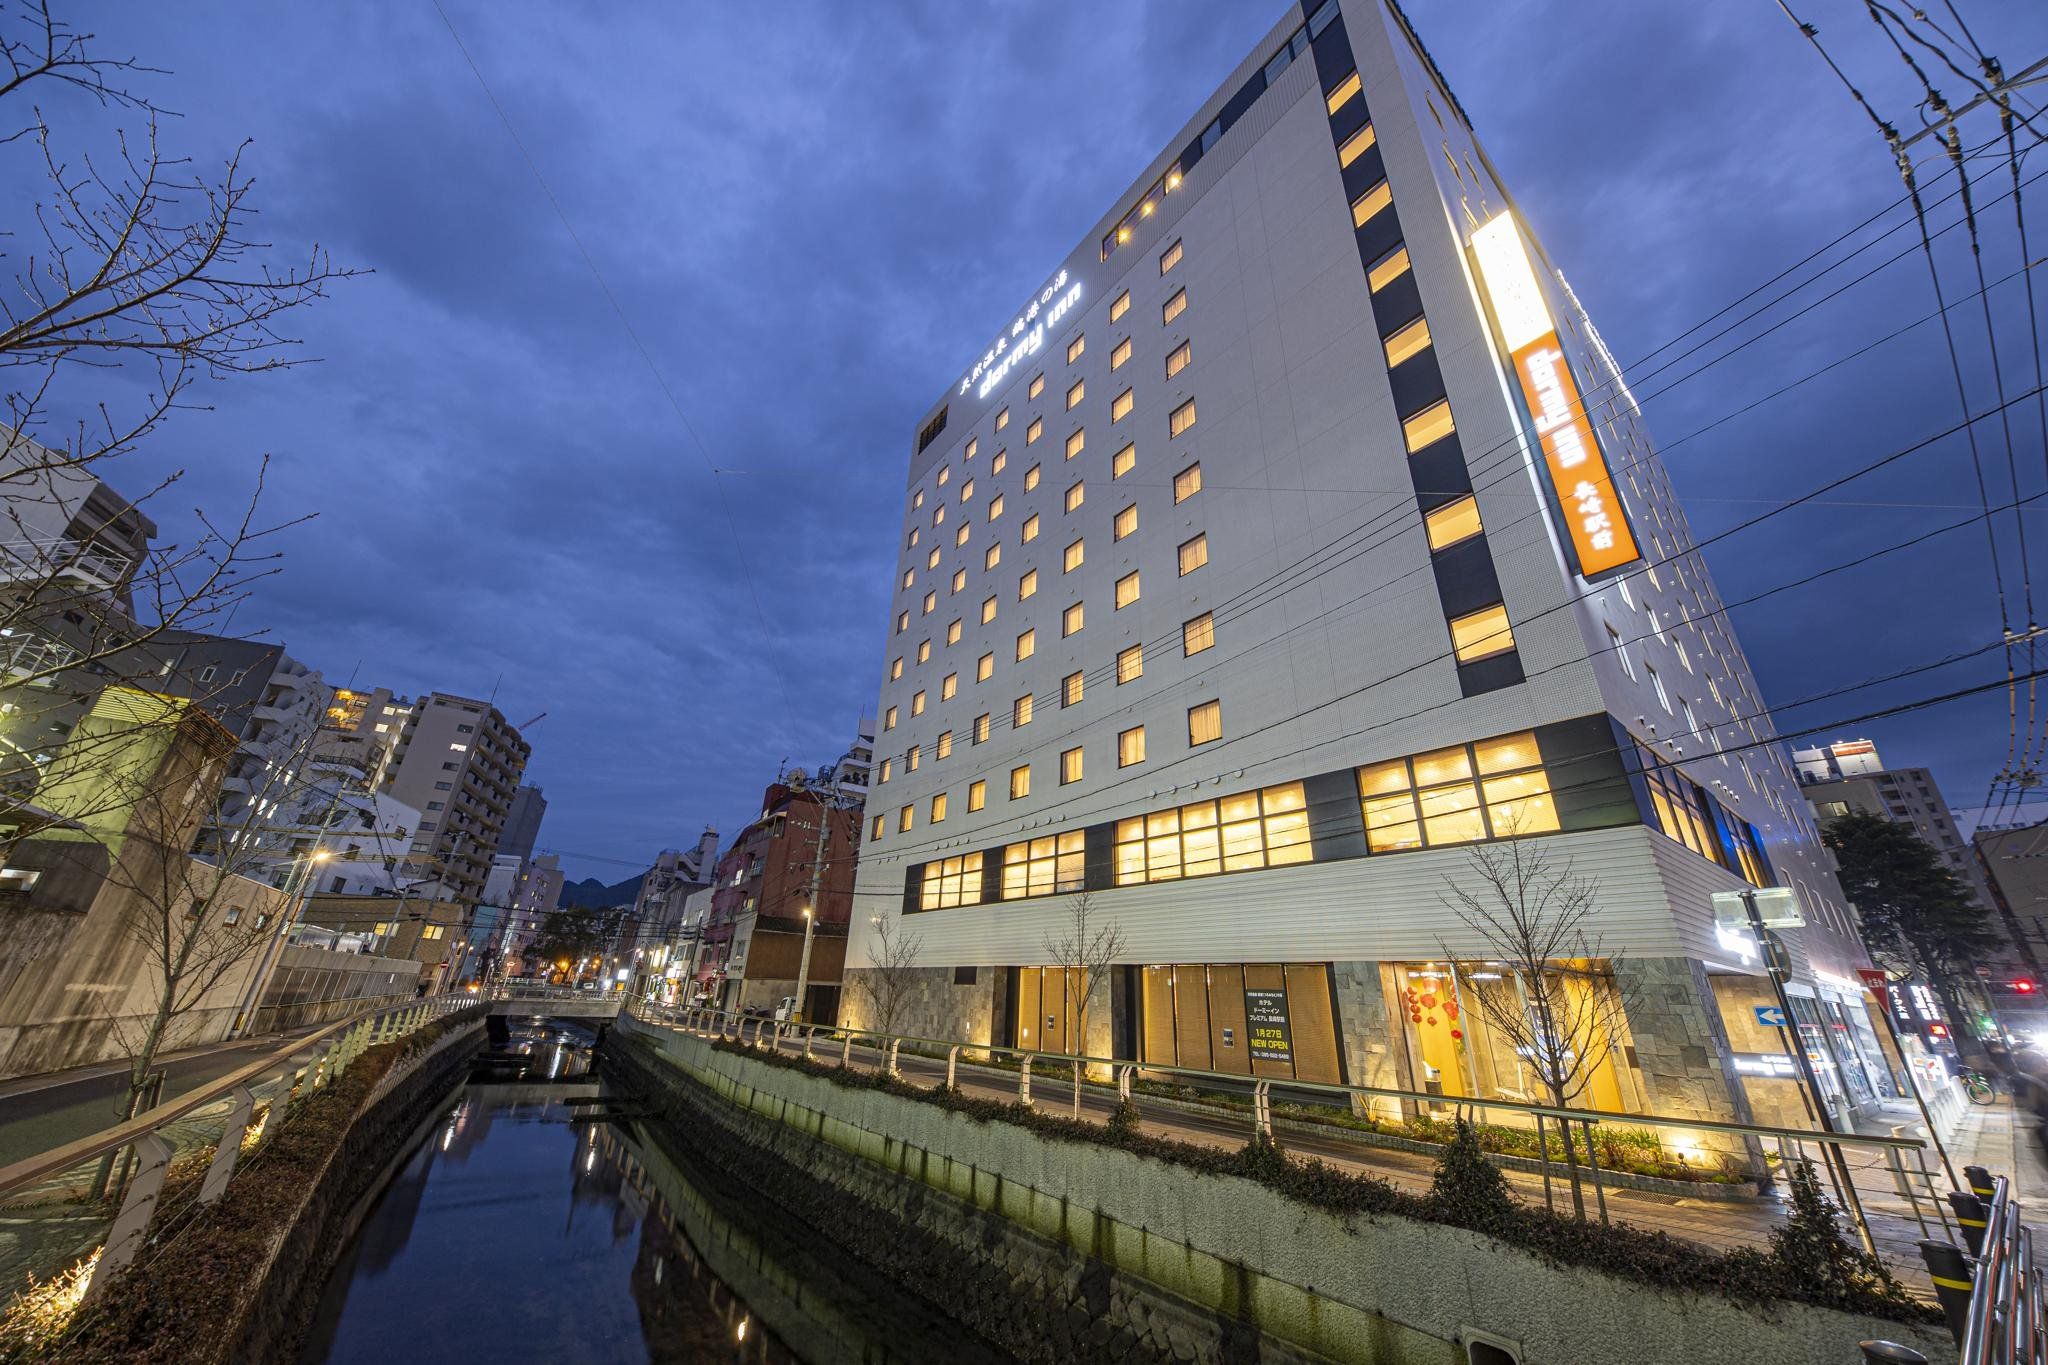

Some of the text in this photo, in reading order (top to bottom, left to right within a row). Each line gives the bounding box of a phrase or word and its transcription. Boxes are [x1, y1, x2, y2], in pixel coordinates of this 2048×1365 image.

[979, 282, 1082, 399] dormy inn
[1526, 350, 1587, 469] dormy inn
[1573, 481, 1613, 550] 長崎駅前
[1251, 1039, 1288, 1049] NEW OPEN
[1256, 1029, 1281, 1038] 1月27日
